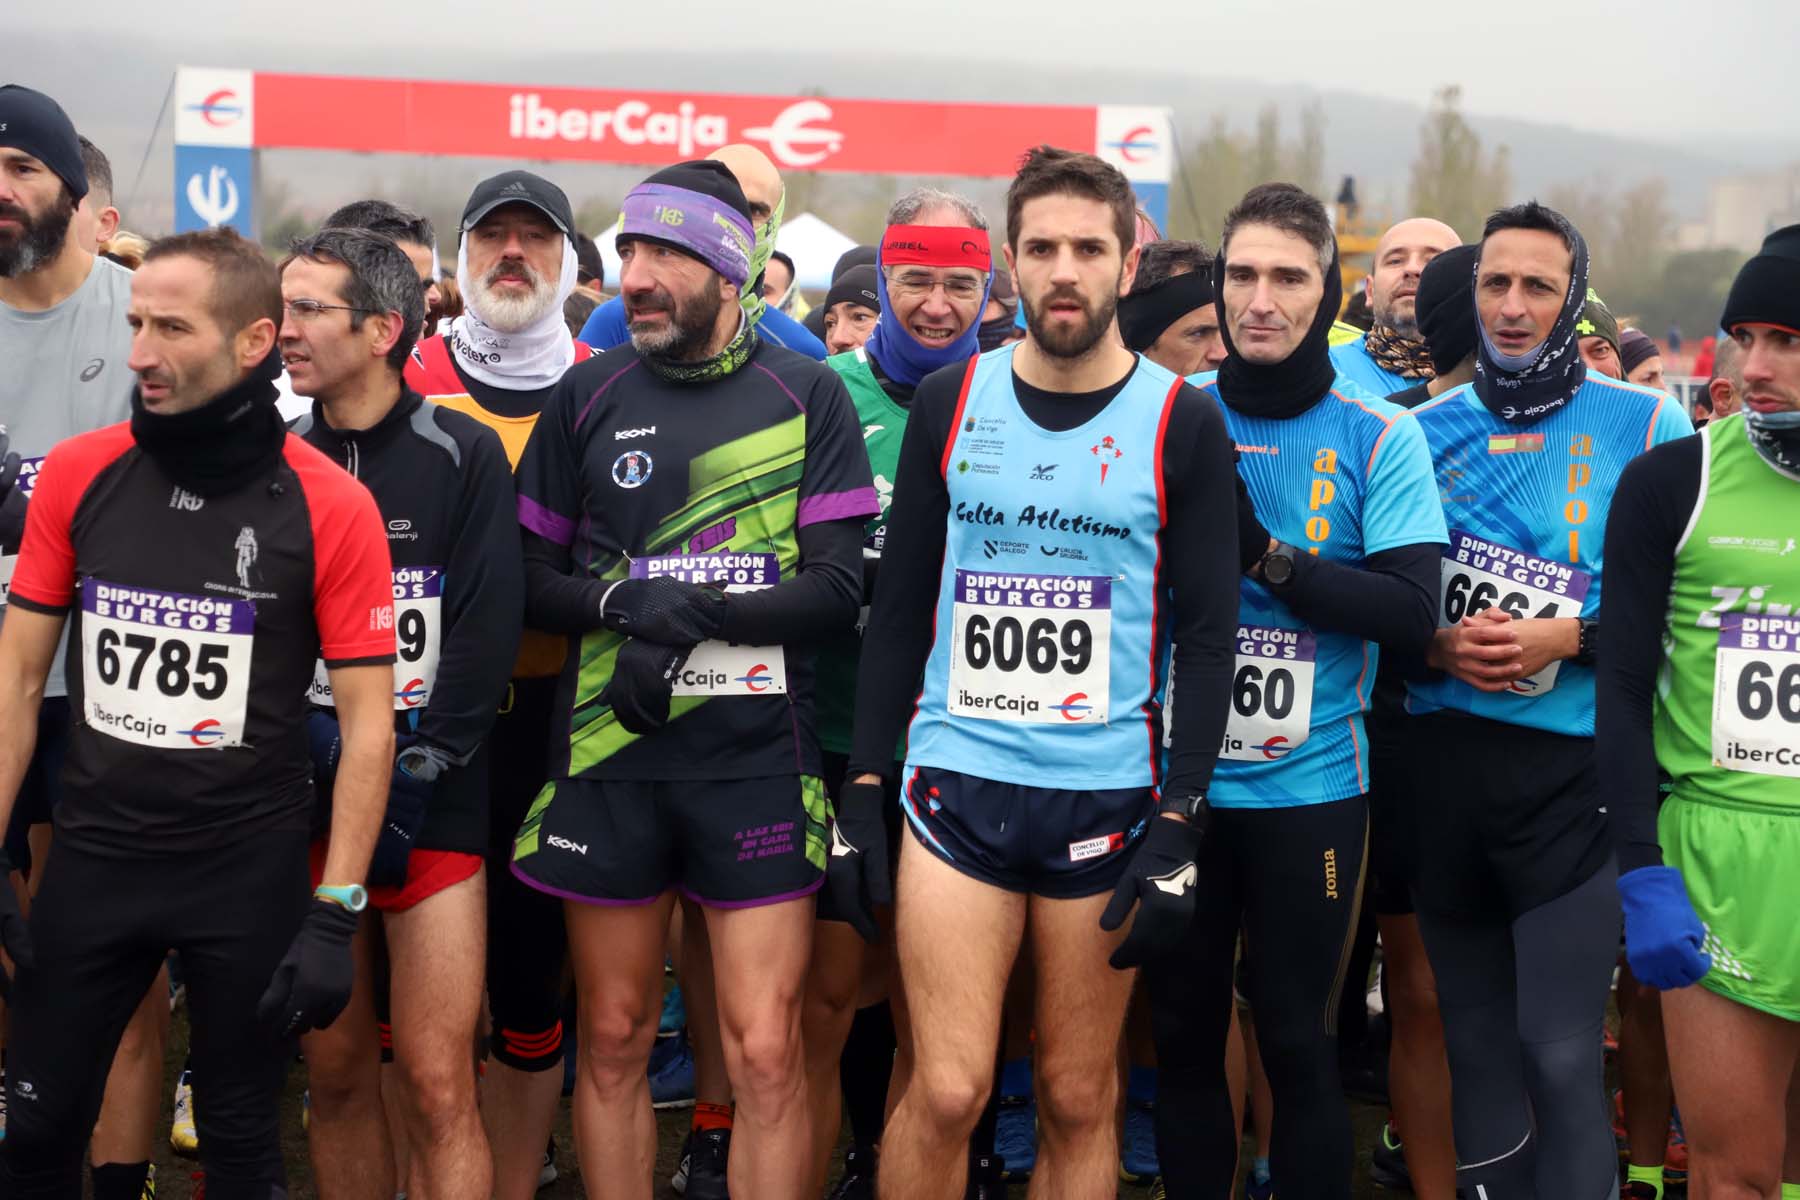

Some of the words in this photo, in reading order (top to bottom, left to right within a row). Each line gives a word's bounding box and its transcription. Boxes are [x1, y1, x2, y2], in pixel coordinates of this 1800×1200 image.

[510, 94, 728, 157] iberCaja
[1306, 448, 1337, 555] apo
[1018, 504, 1132, 540] Atletismo
[648, 553, 766, 572] DIPUTACIÓN
[1456, 549, 1569, 594] BURGOS
[1460, 536, 1573, 581] DIPUTACIÓN
[96, 585, 233, 616] DIPUTACIÓN
[966, 575, 1092, 593] DIPUTACIÓN
[966, 590, 1092, 608] BURGOS
[96, 600, 232, 633] BURGOS
[965, 614, 1093, 675] 6069
[1236, 626, 1298, 645] ACIÓN
[1240, 640, 1297, 659] GOS
[97, 628, 229, 701] 6785
[959, 690, 1040, 714] iberCaja
[1232, 664, 1295, 720] 60
[1737, 660, 1800, 723] 66
[93, 703, 167, 739] iberCaja
[1727, 742, 1800, 765] iberCa
[1072, 840, 1105, 852] CONCELLO
